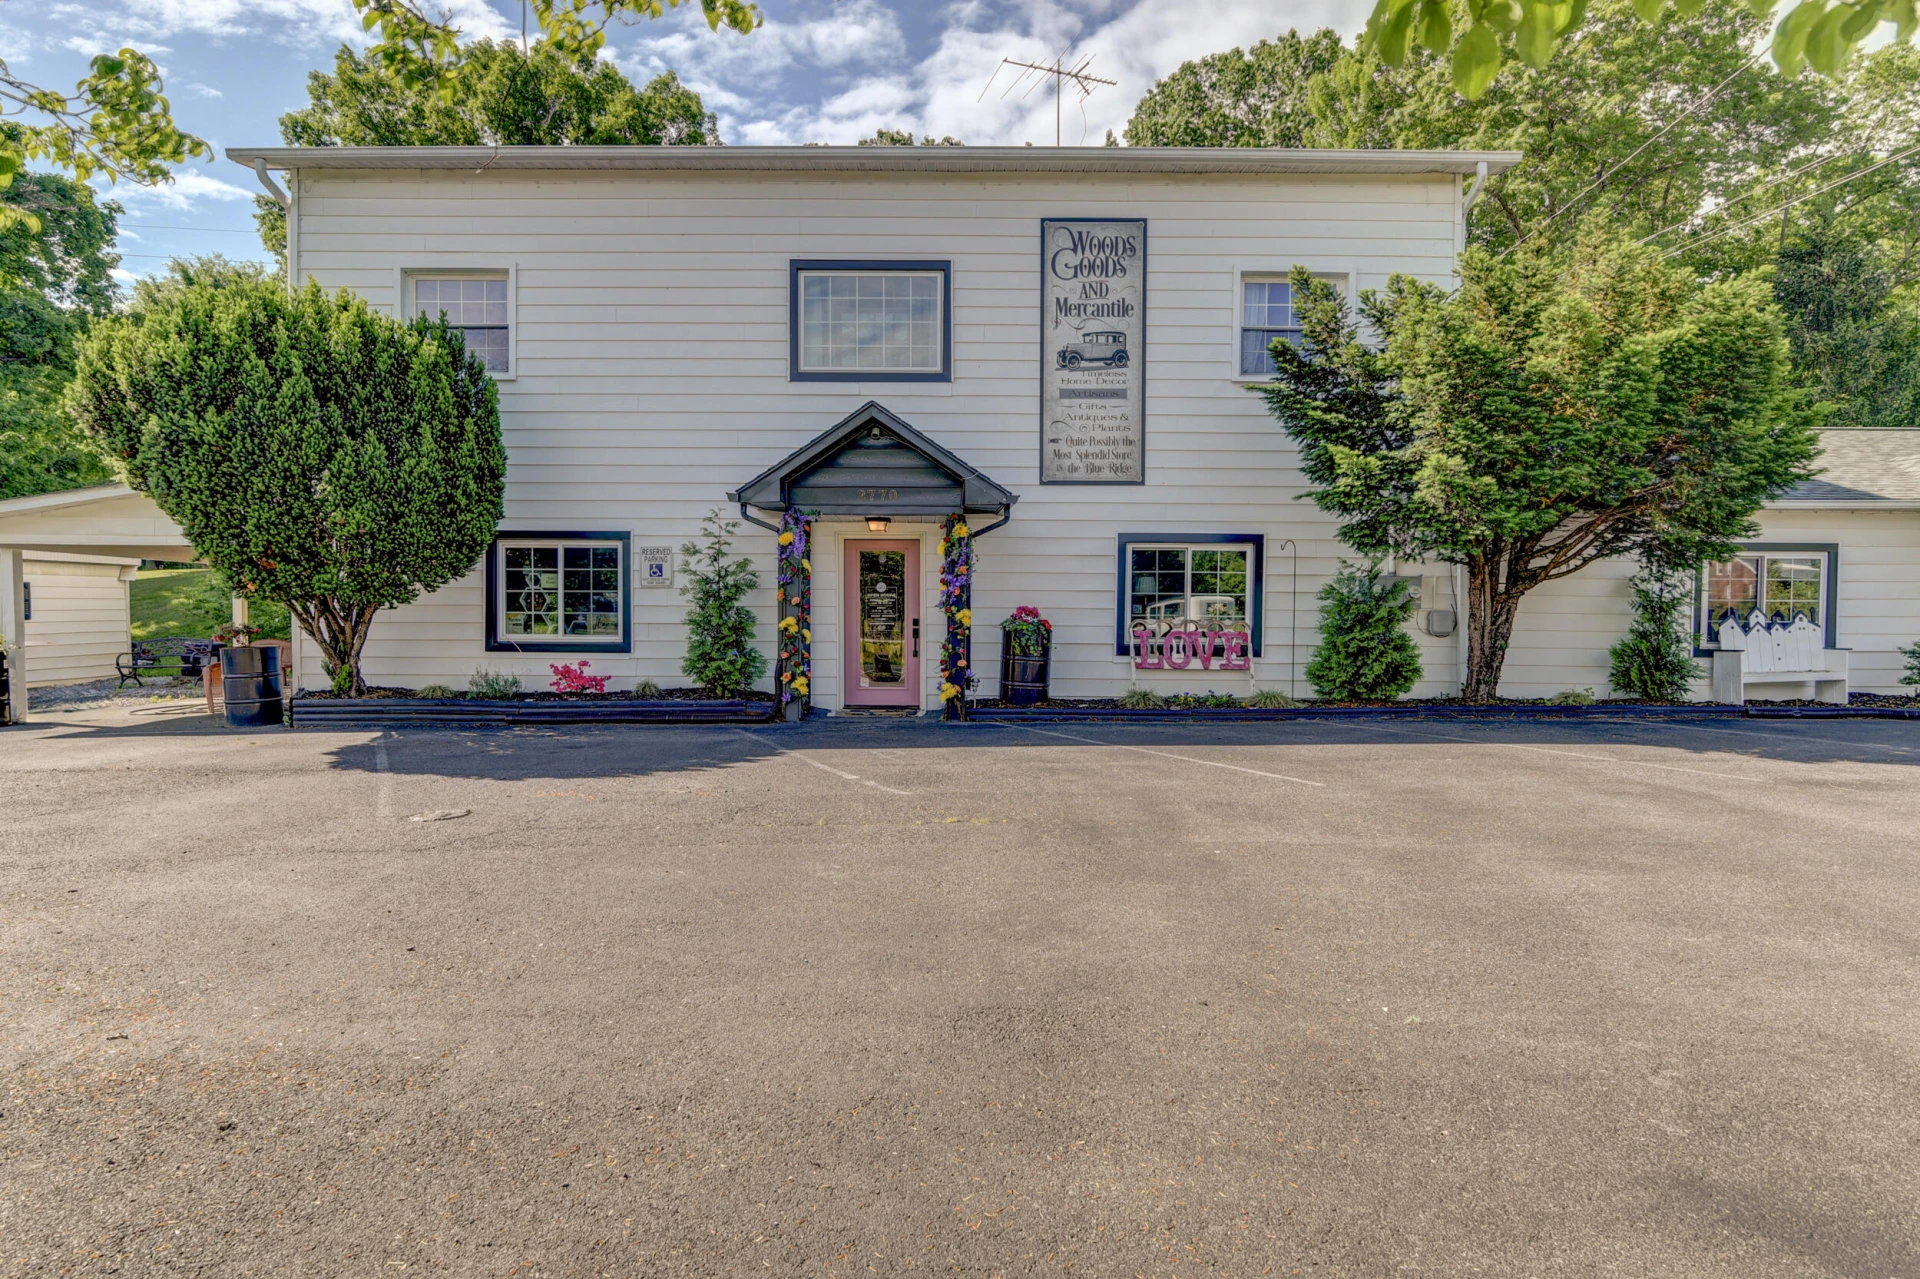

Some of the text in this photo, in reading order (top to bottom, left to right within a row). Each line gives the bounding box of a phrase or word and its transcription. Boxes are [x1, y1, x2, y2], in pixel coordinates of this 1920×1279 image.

[1079, 282, 1110, 299] AND
[1053, 297, 1135, 328] Mercantile
[1081, 370, 1128, 378] Timeless
[1060, 377, 1129, 386] Home Decor
[1067, 388, 1120, 398] Artisans
[1078, 402, 1107, 411] Gifts
[1063, 412, 1129, 423] Antiques &
[1092, 423, 1131, 432] Plants
[1065, 435, 1136, 451] Quite Possibly the
[1053, 448, 1132, 463] Most Splendid Store
[1067, 462, 1081, 474] the
[1085, 461, 1105, 475] Blue
[1108, 461, 1133, 477] Ridge
[857, 488, 898, 502] 2770
[641, 548, 671, 556] RESERVED
[644, 555, 668, 563] PARKING
[1133, 629, 1250, 670] LOVE
